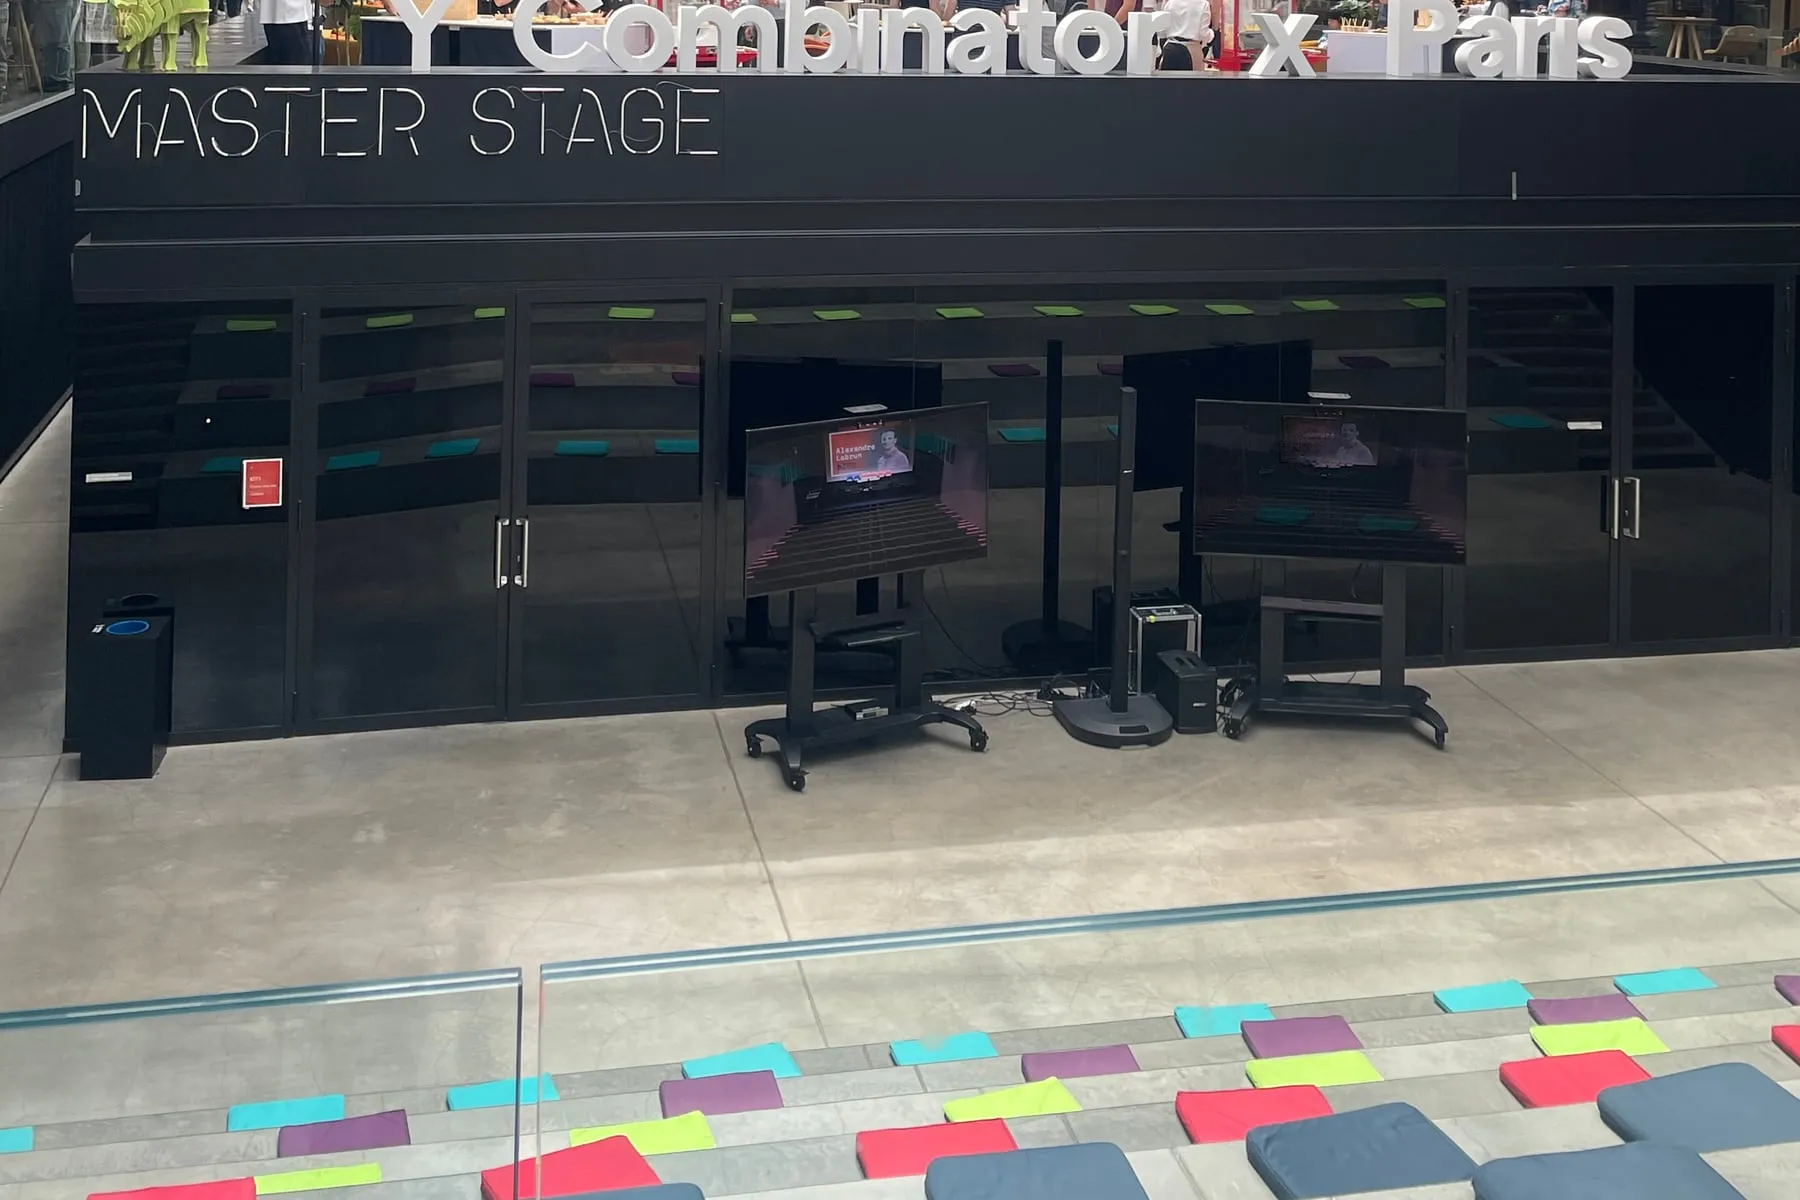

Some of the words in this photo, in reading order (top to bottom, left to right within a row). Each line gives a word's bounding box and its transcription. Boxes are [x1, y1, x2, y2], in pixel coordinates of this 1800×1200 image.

[1249, 13, 1320, 77] x
[82, 87, 426, 158] MASTER
[470, 86, 721, 156] STAGE
